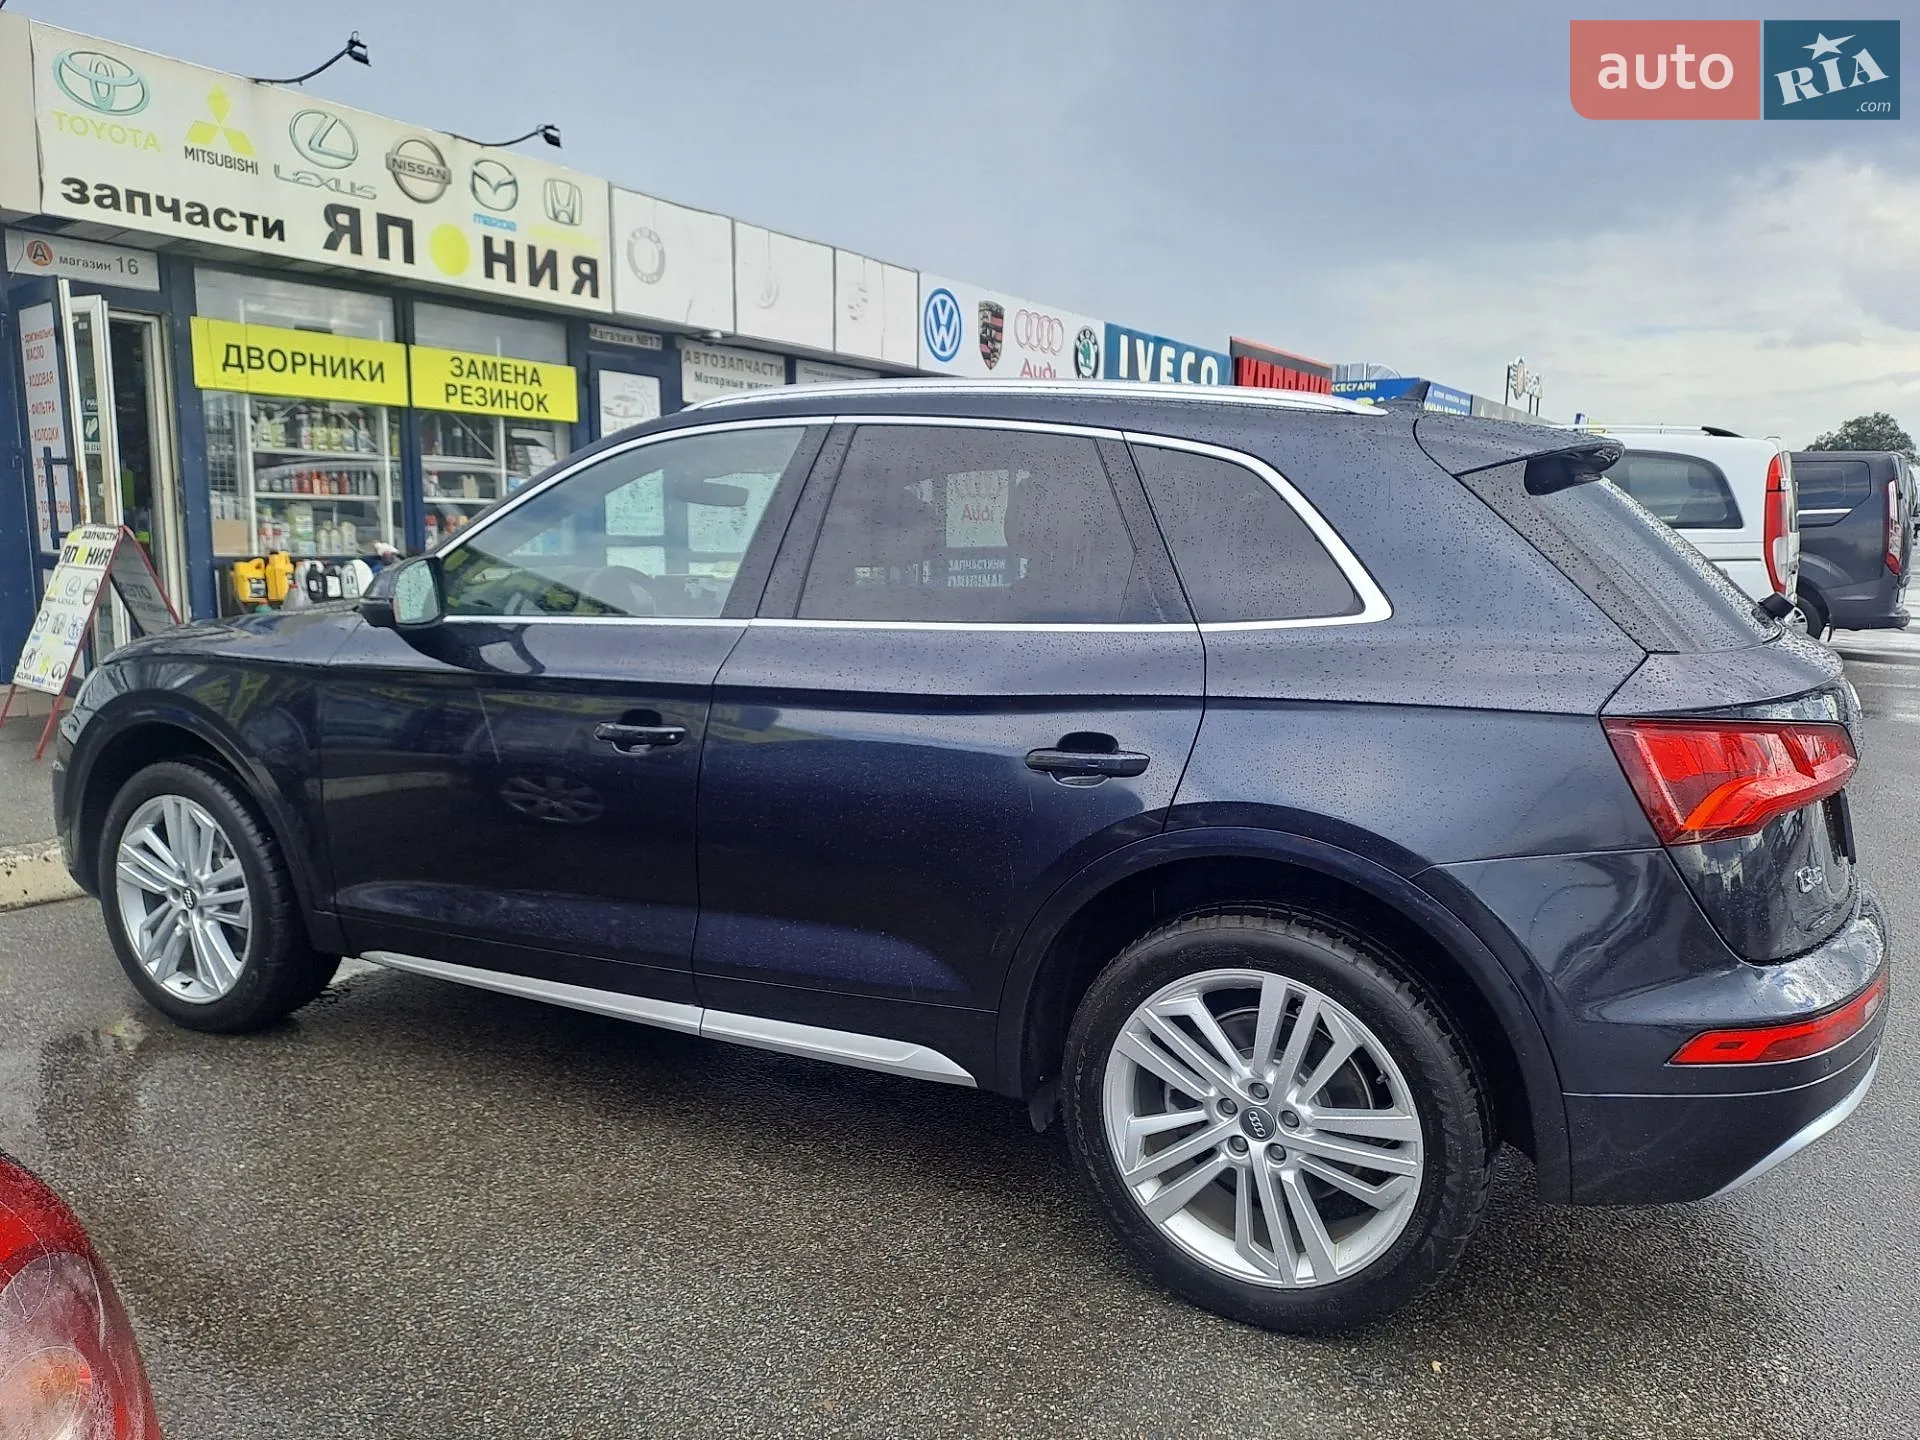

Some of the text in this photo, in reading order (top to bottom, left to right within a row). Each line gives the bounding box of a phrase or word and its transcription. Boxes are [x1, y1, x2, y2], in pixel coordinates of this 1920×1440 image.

[52, 110, 160, 152] TOYOTA
[184, 146, 259, 175] MITSUBISHI
[390, 157, 448, 181] NISSAN
[273, 163, 377, 201] LEXUS
[61, 177, 286, 242] запчасти
[59, 256, 112, 271] магазин
[116, 256, 139, 275] 16
[222, 343, 386, 383] ДВОРНИКИ
[450, 356, 542, 388] ЗАМЕНА
[683, 349, 784, 377] АВТОЗАПЧАСТИ
[1020, 357, 1057, 379] Audi
[1118, 333, 1219, 385] IVECO
[694, 371, 744, 389] Моторные
[445, 383, 550, 413] РЕЗИНОК
[960, 504, 995, 523] Audi
